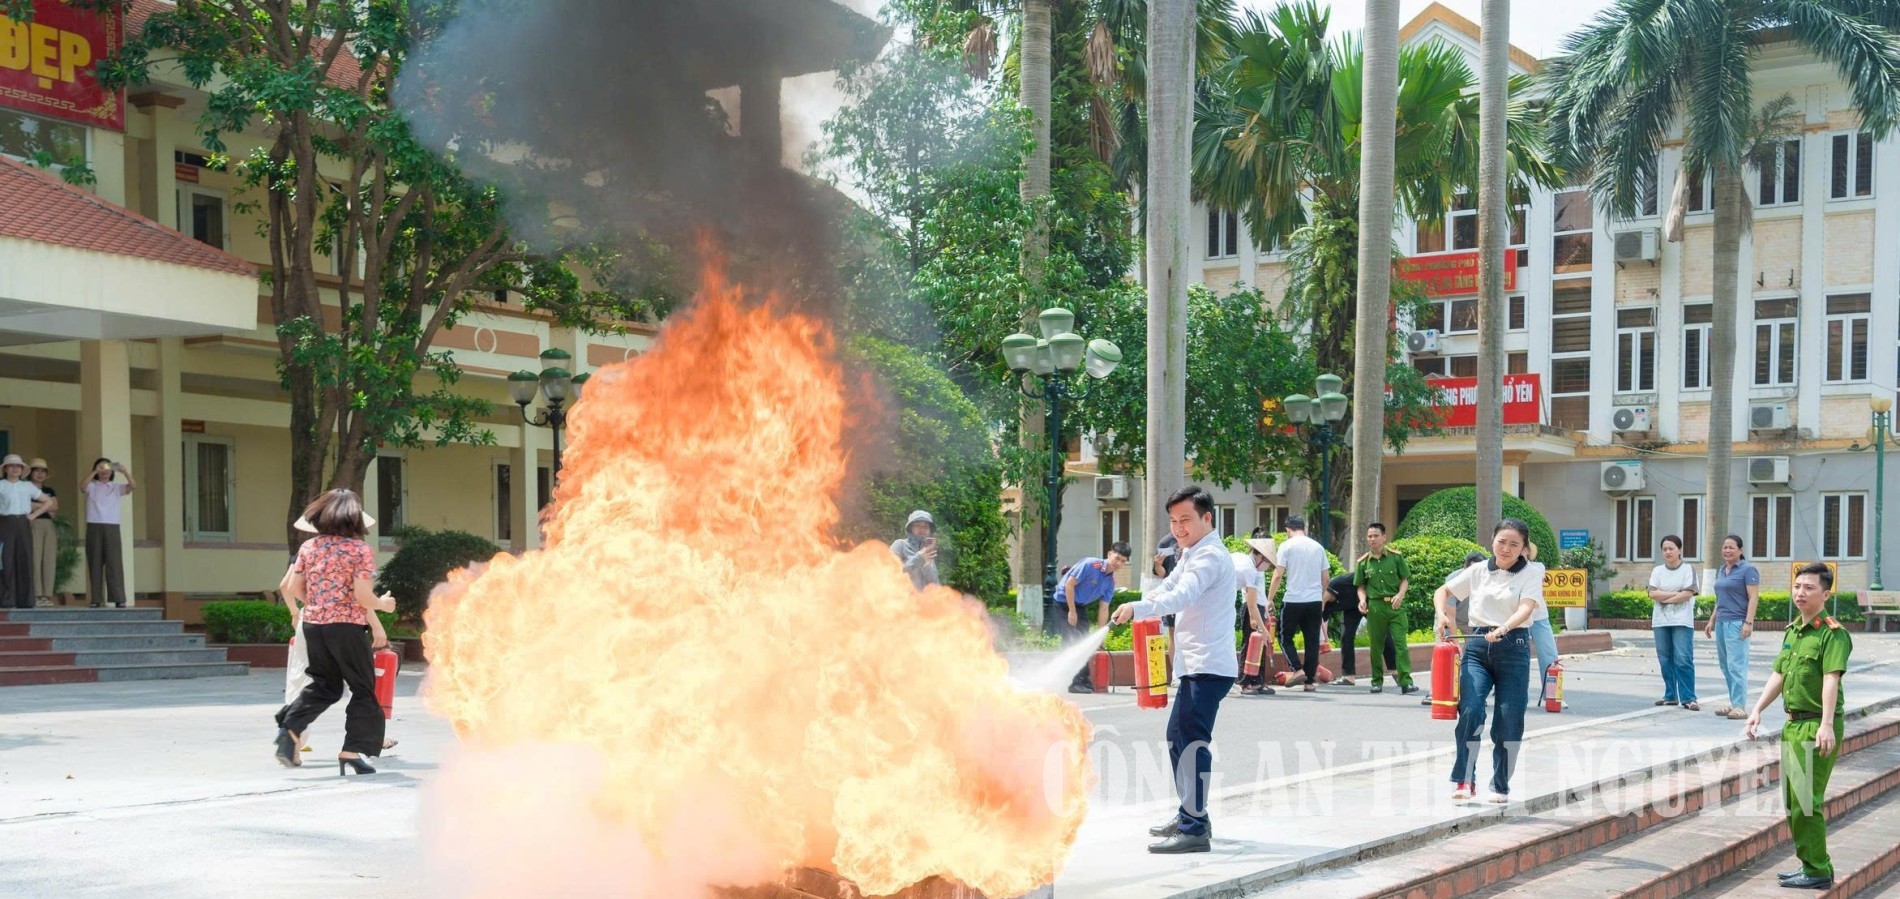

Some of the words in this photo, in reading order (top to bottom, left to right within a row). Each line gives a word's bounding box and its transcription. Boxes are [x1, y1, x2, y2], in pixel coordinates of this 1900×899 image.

[0, 14, 91, 90] ĐẸP
[1502, 377, 1513, 404] HỔ
[1515, 380, 1533, 402] YÊN
